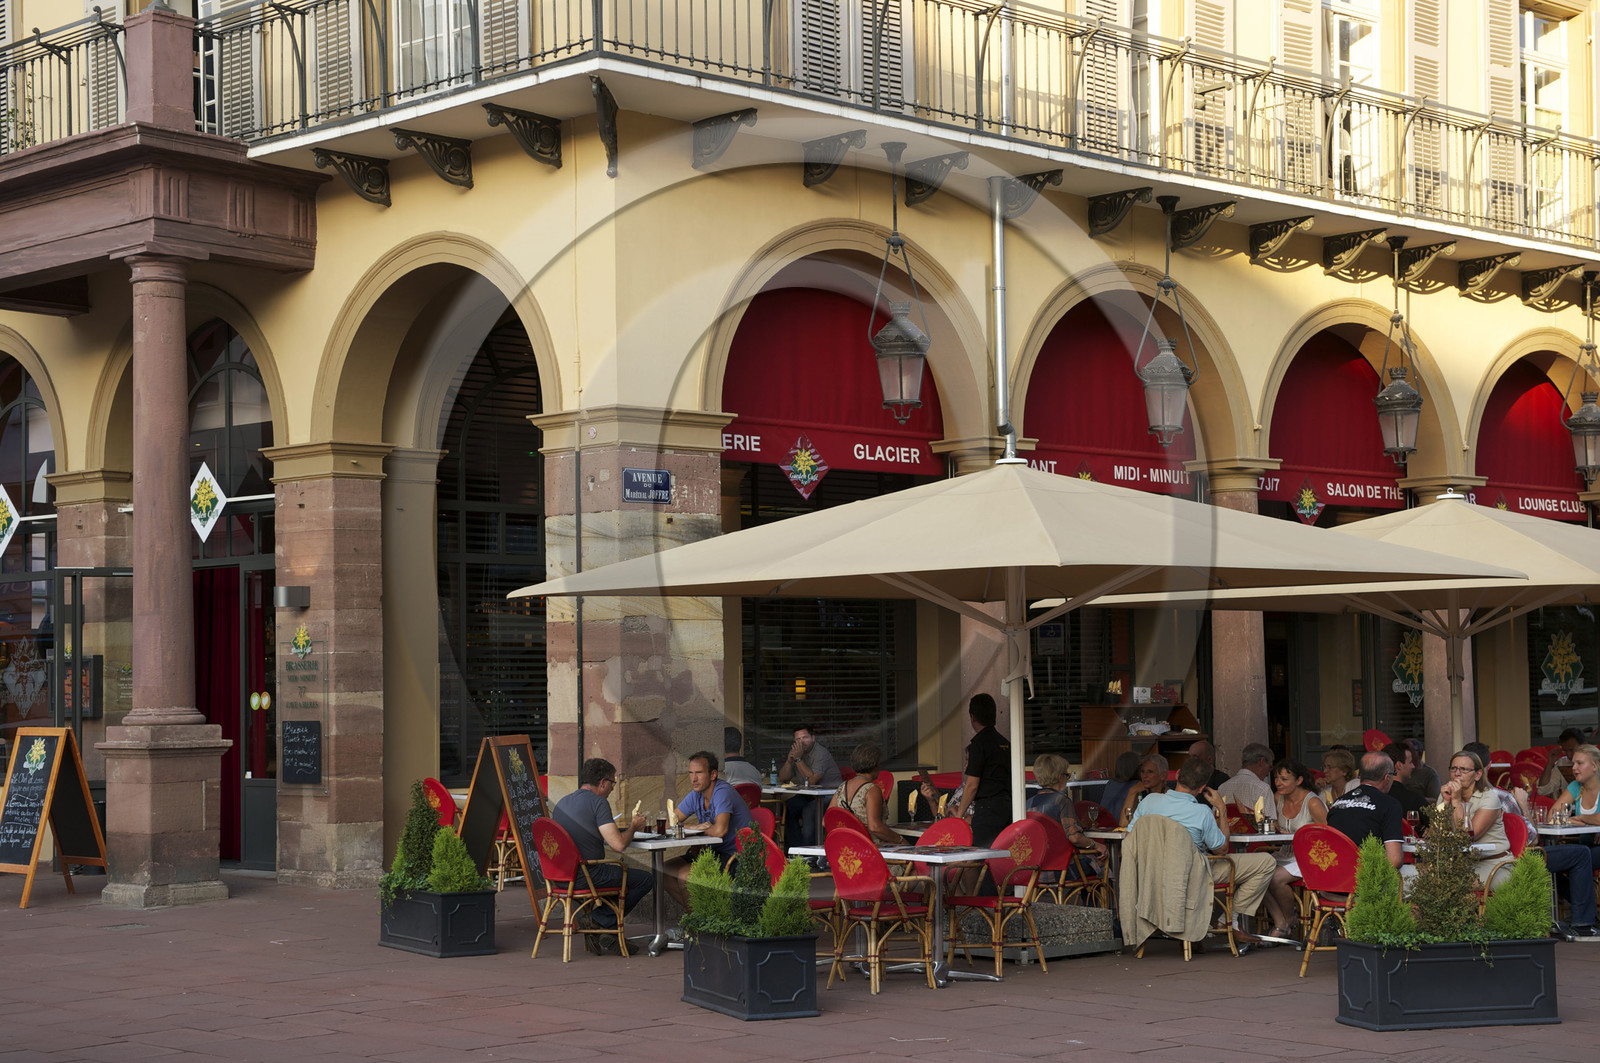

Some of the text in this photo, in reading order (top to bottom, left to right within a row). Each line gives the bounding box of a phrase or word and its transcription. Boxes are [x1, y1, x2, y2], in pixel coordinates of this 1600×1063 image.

[722, 433, 761, 452] ERIE
[853, 443, 921, 464] GLACIER
[1026, 458, 1058, 475] ANT
[1113, 465, 1141, 482] MIDI
[1149, 467, 1191, 485] MINUIT
[632, 472, 663, 484] AVENUE
[648, 489, 669, 500] JOFFRE
[1326, 482, 1364, 498] SALON
[1366, 485, 1381, 499] DE
[1518, 497, 1587, 513] LOUNGE CLUB
